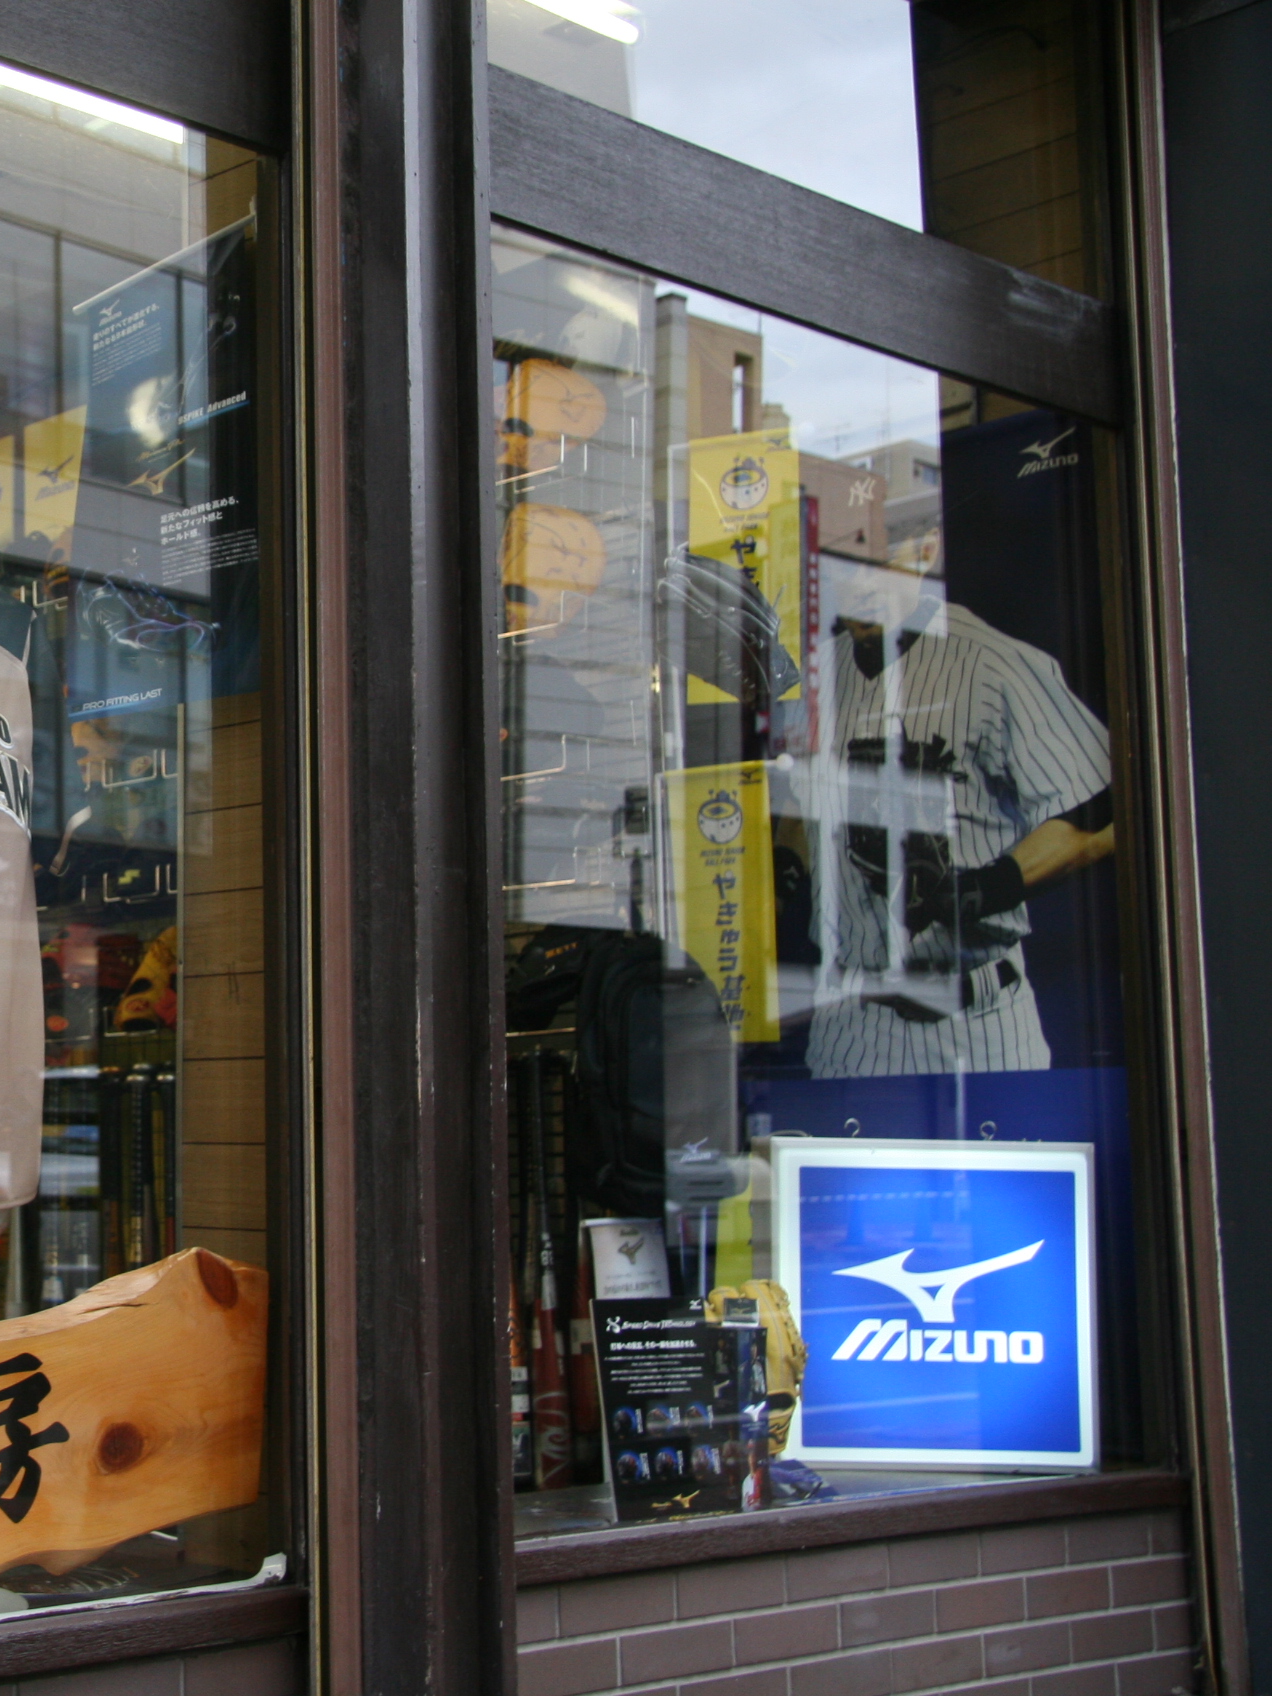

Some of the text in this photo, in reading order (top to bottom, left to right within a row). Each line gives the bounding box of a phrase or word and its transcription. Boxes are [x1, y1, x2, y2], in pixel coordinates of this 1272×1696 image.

[1016, 452, 1080, 480] MIZUNO
[82, 698, 106, 712] PRO
[140, 687, 162, 701] LAST
[830, 1317, 1045, 1365] MIZUNO
